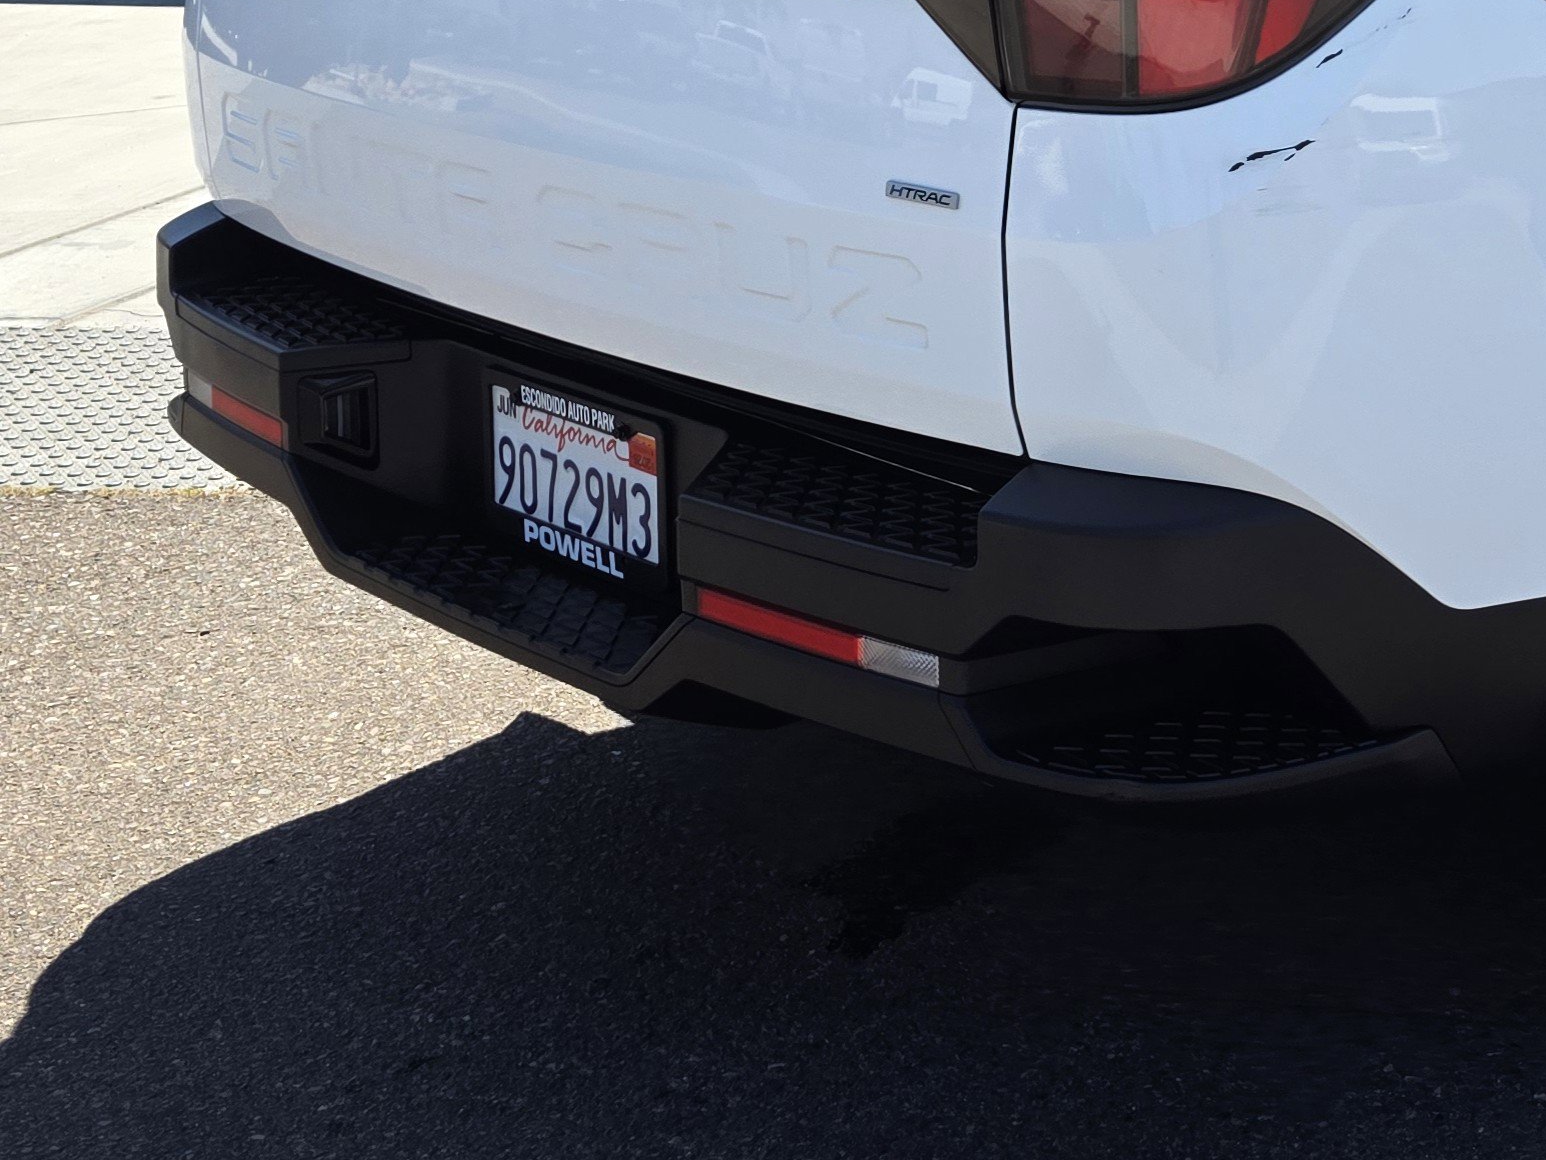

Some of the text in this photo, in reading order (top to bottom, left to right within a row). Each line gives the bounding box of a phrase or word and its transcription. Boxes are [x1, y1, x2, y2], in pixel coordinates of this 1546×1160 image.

[889, 183, 953, 207] HTRAC
[521, 384, 616, 434] ESCONDIDO AUTO PARK
[522, 405, 628, 460] California
[498, 435, 652, 559] 90729M3
[523, 518, 625, 580] POWELL
